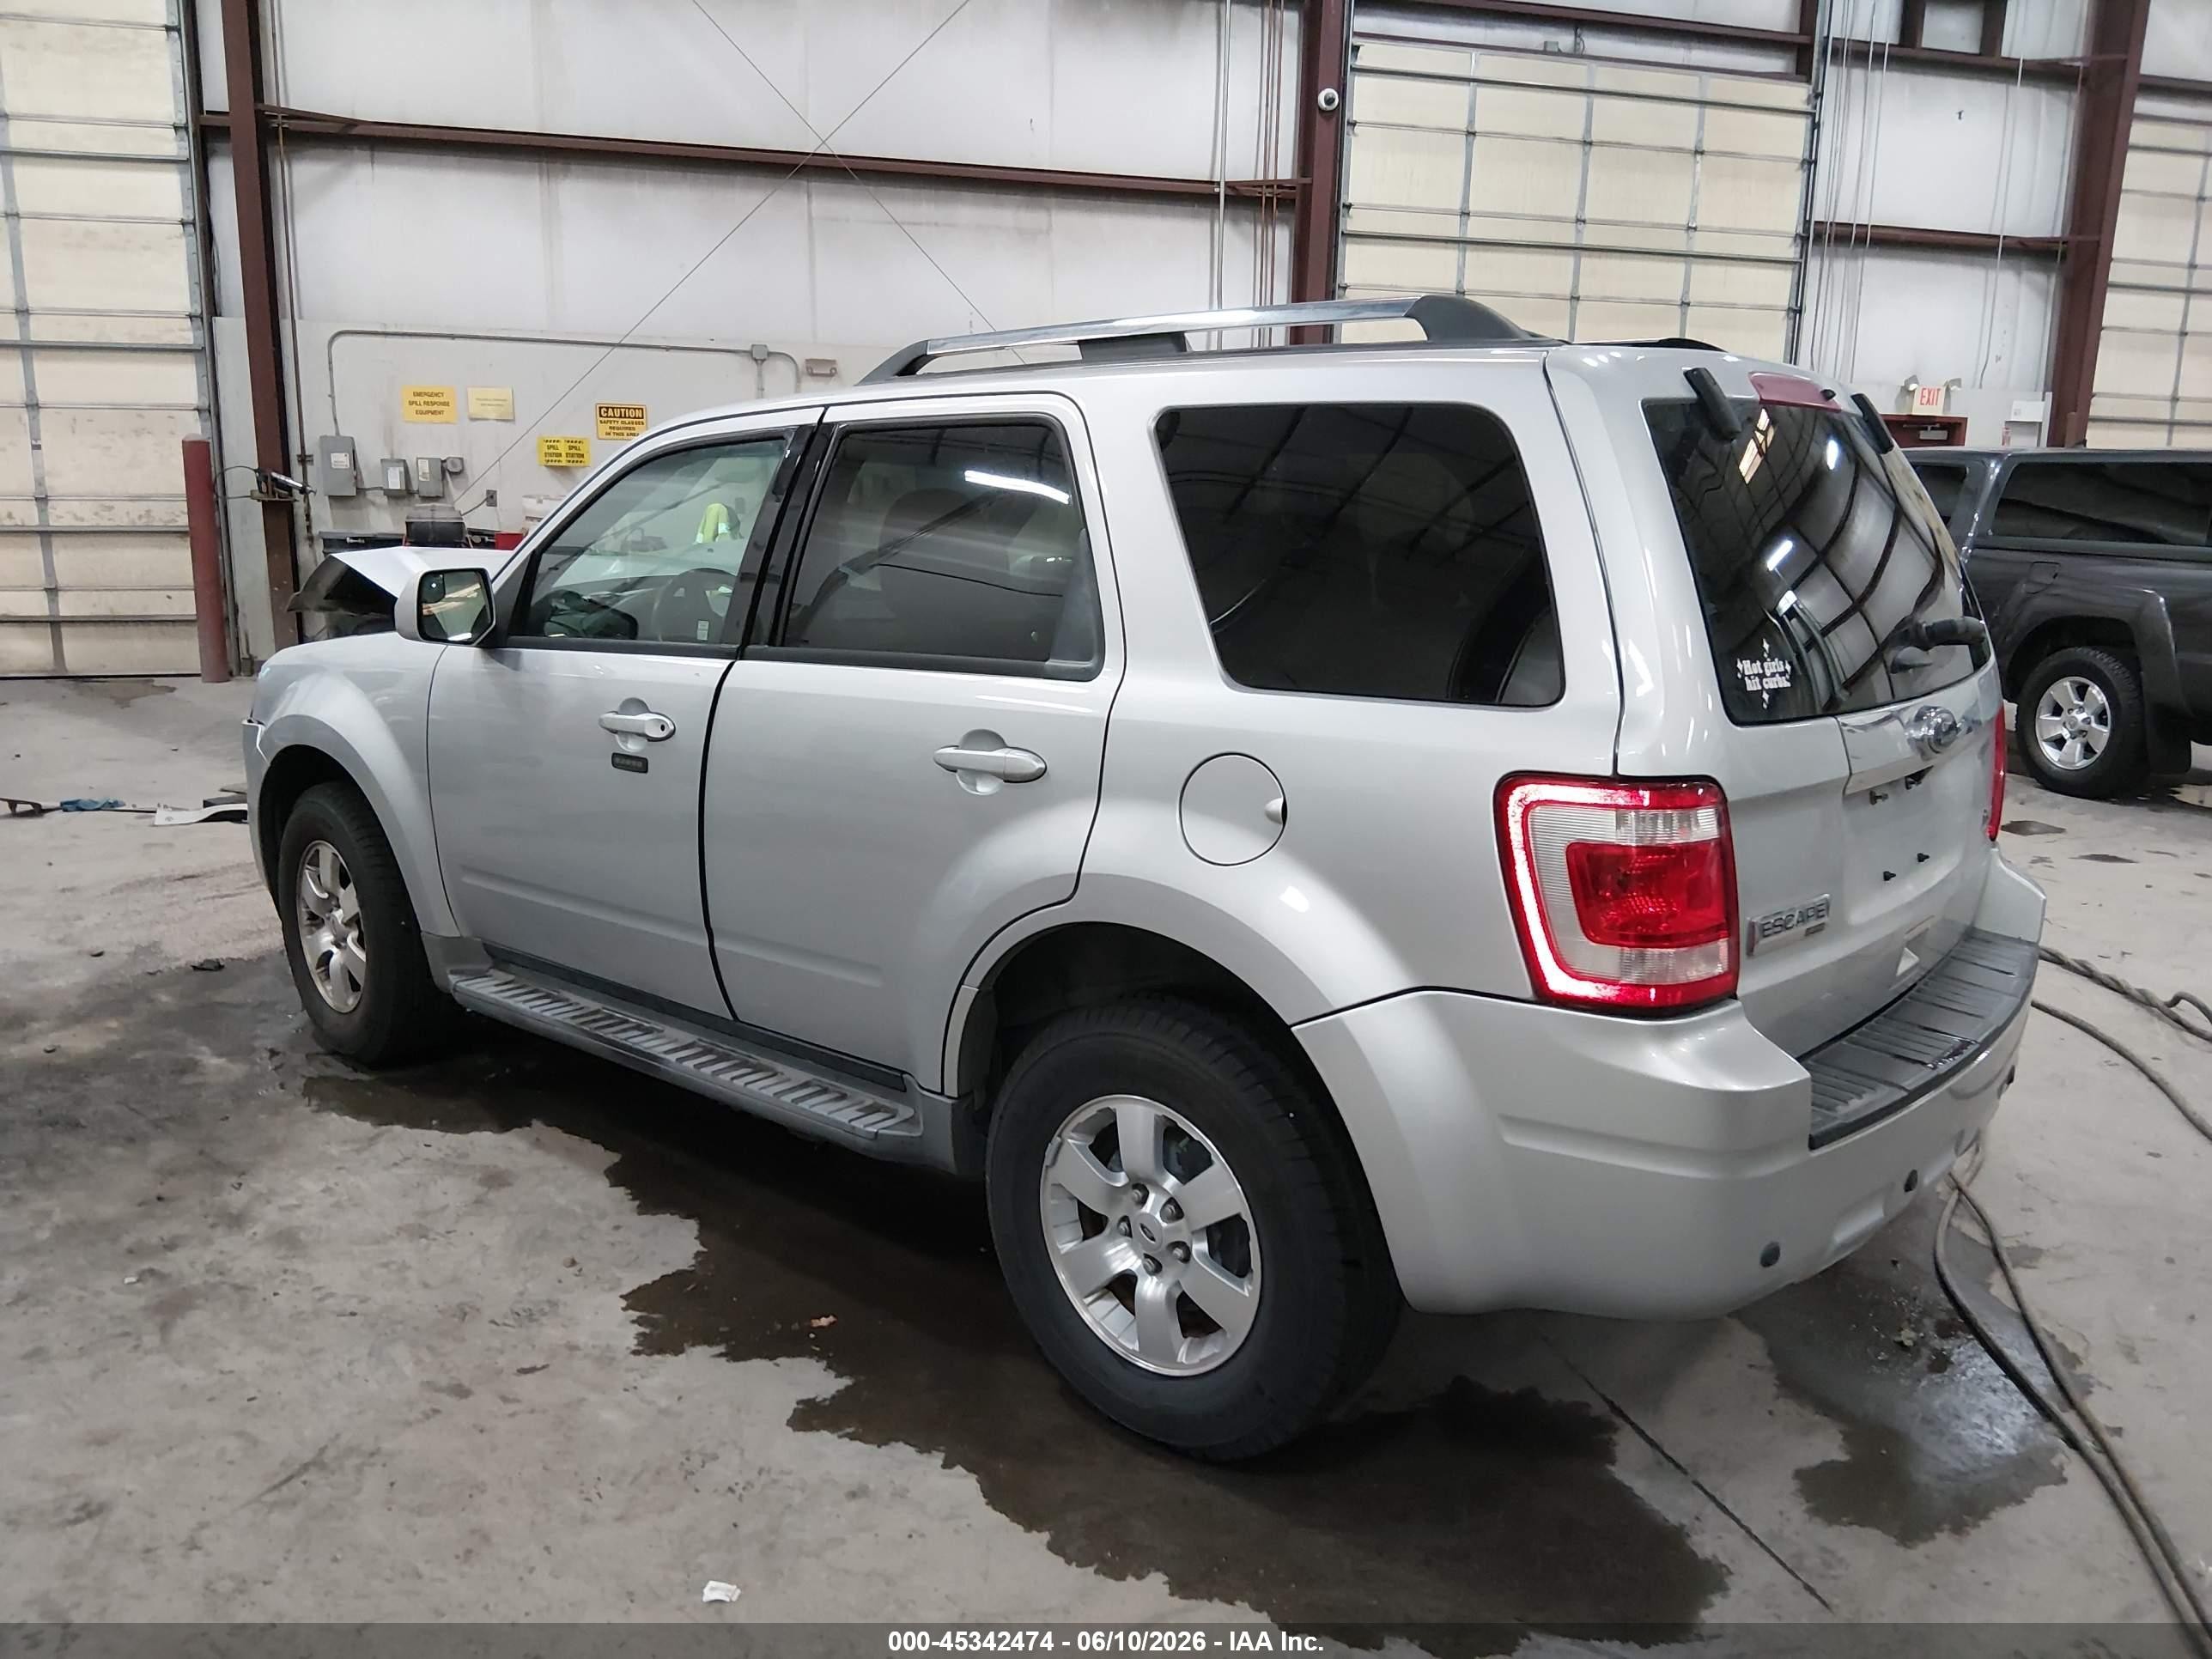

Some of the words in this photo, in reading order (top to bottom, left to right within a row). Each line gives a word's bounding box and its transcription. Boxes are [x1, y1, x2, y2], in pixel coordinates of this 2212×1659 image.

[1920, 387, 1942, 406] EXIT
[600, 408, 643, 418] CAUTION
[1742, 659, 1763, 675] Hot
[1763, 658, 1785, 677] girls
[1744, 676, 1762, 690] hit
[1761, 902, 1826, 938] ESCAPE
